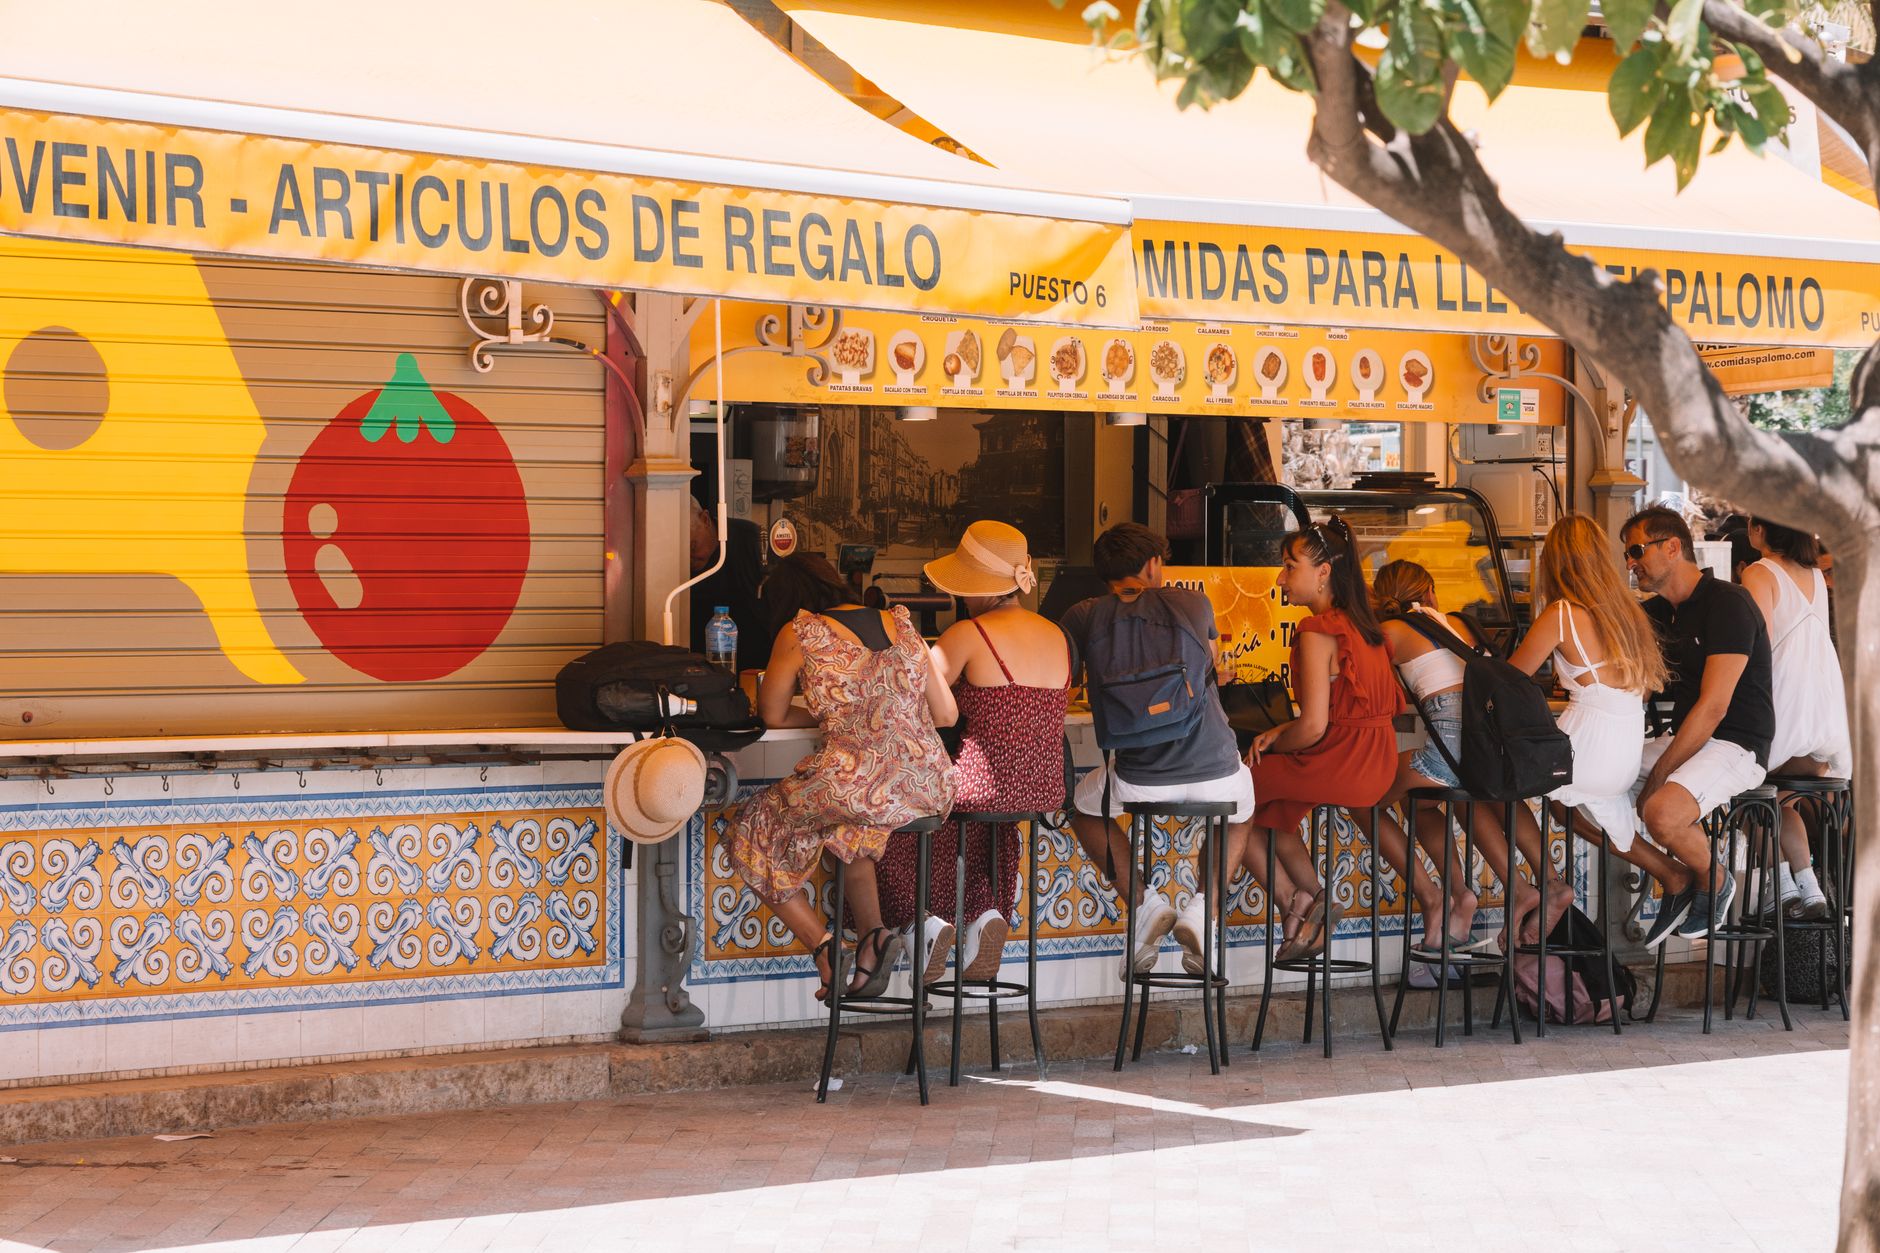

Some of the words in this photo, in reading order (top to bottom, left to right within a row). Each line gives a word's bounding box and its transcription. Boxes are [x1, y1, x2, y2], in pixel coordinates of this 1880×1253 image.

[0, 137, 206, 228] VENIR
[269, 163, 610, 261] ARTICULOS
[633, 193, 704, 268] DE
[724, 204, 942, 291] REGALO
[1010, 272, 1088, 305] PUESTO
[1096, 284, 1107, 308] 6
[1132, 240, 1289, 304] MIDAS
[1305, 247, 1420, 309] PARA
[1666, 268, 1824, 332] PALOMO
[922, 315, 957, 323] CROQUETAS
[1704, 350, 1816, 369] w.comidaspalomo.com
